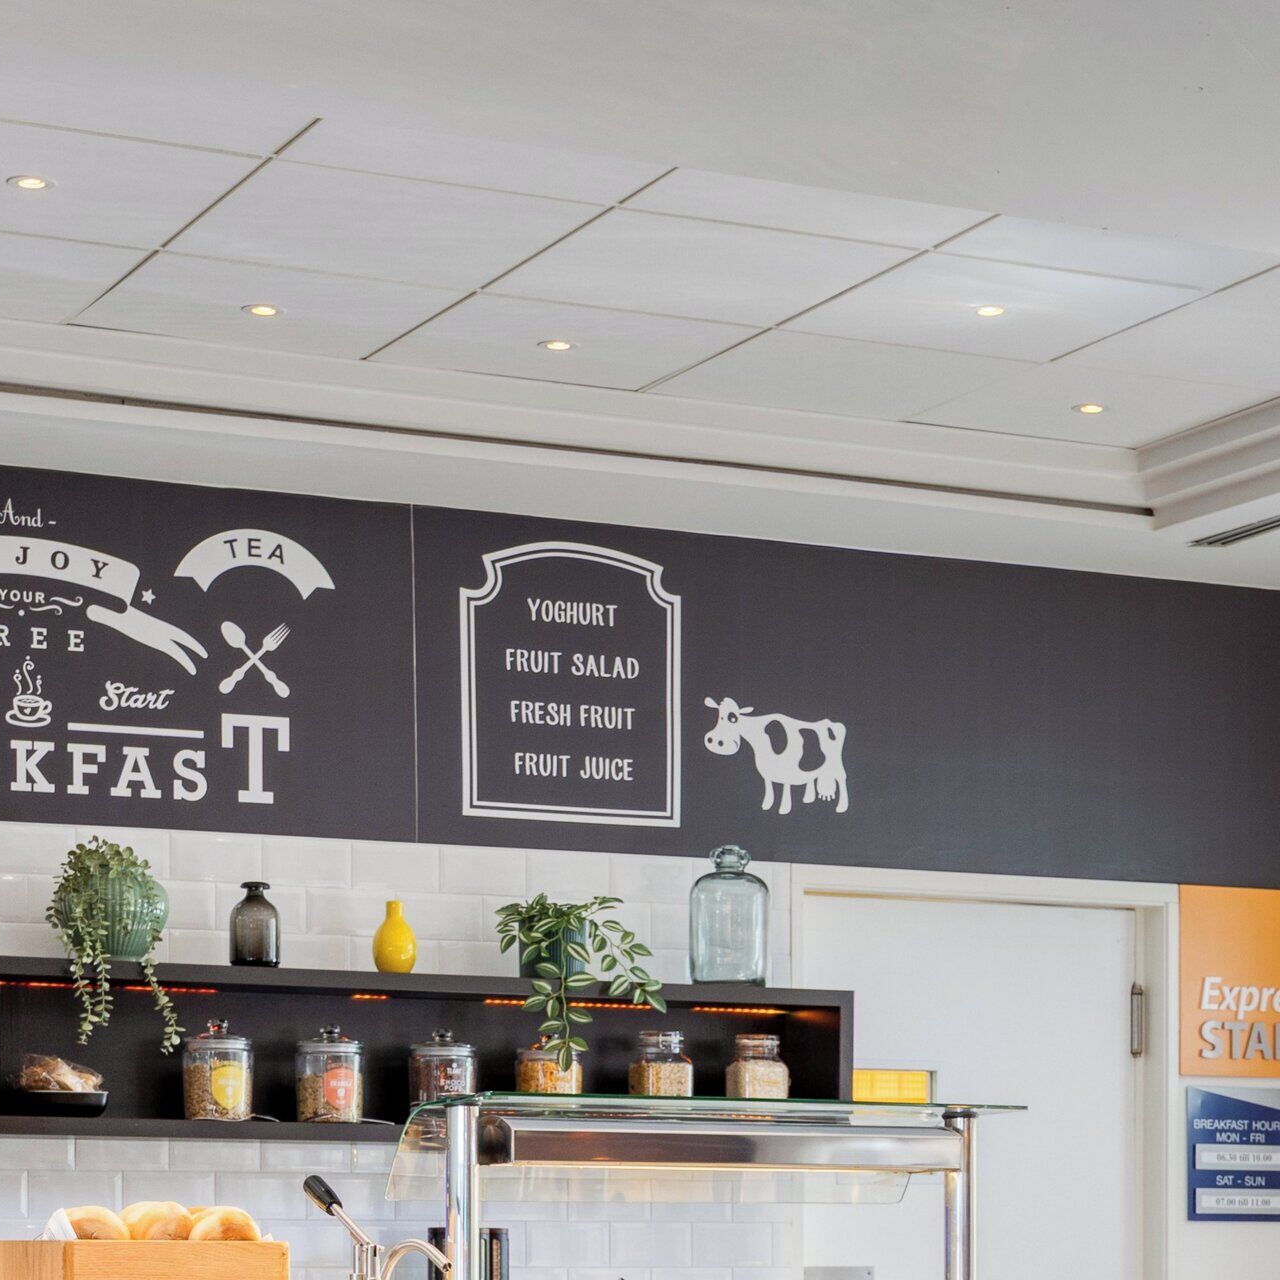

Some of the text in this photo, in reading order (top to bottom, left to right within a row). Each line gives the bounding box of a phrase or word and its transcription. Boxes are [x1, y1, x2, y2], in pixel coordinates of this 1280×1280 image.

[224, 538, 284, 564] TEA
[527, 597, 618, 627] YOGHURT
[505, 648, 640, 680] FRUIT SALAD
[98, 680, 177, 712] Start
[510, 700, 636, 730] FRESH FRUIT
[514, 752, 634, 781] FRUIT JUICE
[1193, 1119, 1249, 1131] BREAKFAST
[1216, 1132, 1240, 1142] MON
[1250, 1133, 1265, 1143] FRI
[1216, 1175, 1234, 1186] SAT
[1244, 1176, 1265, 1186] SUN
